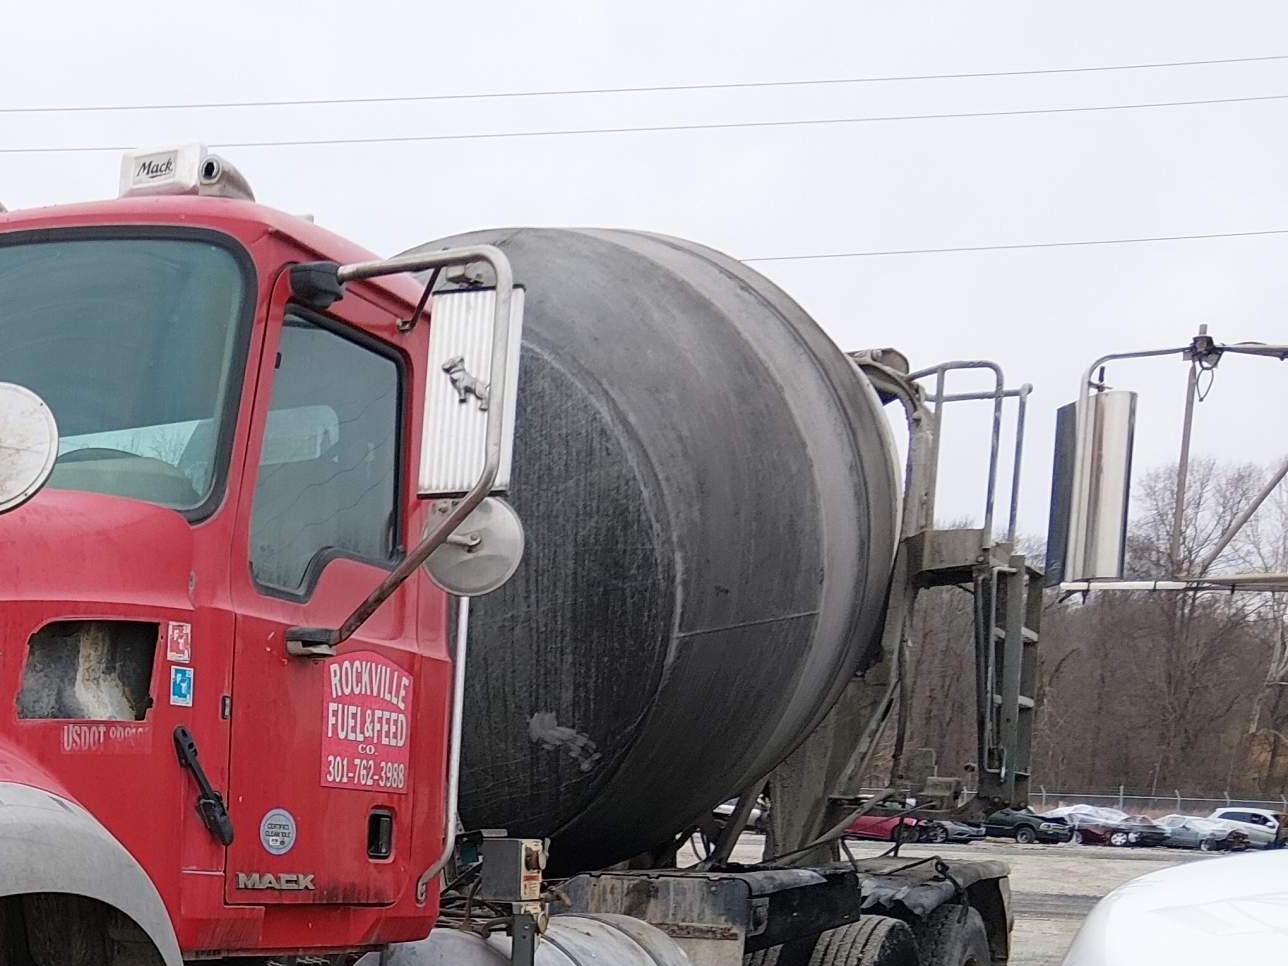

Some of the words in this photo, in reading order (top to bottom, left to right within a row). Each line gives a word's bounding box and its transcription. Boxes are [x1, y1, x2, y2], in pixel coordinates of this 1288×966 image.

[136, 157, 174, 179] Mack
[329, 659, 409, 711] ROCKVILLE
[63, 724, 106, 752] USDOT
[358, 744, 379, 755] CO.
[327, 755, 405, 788] 301-762-3988
[235, 872, 316, 890] MACK
